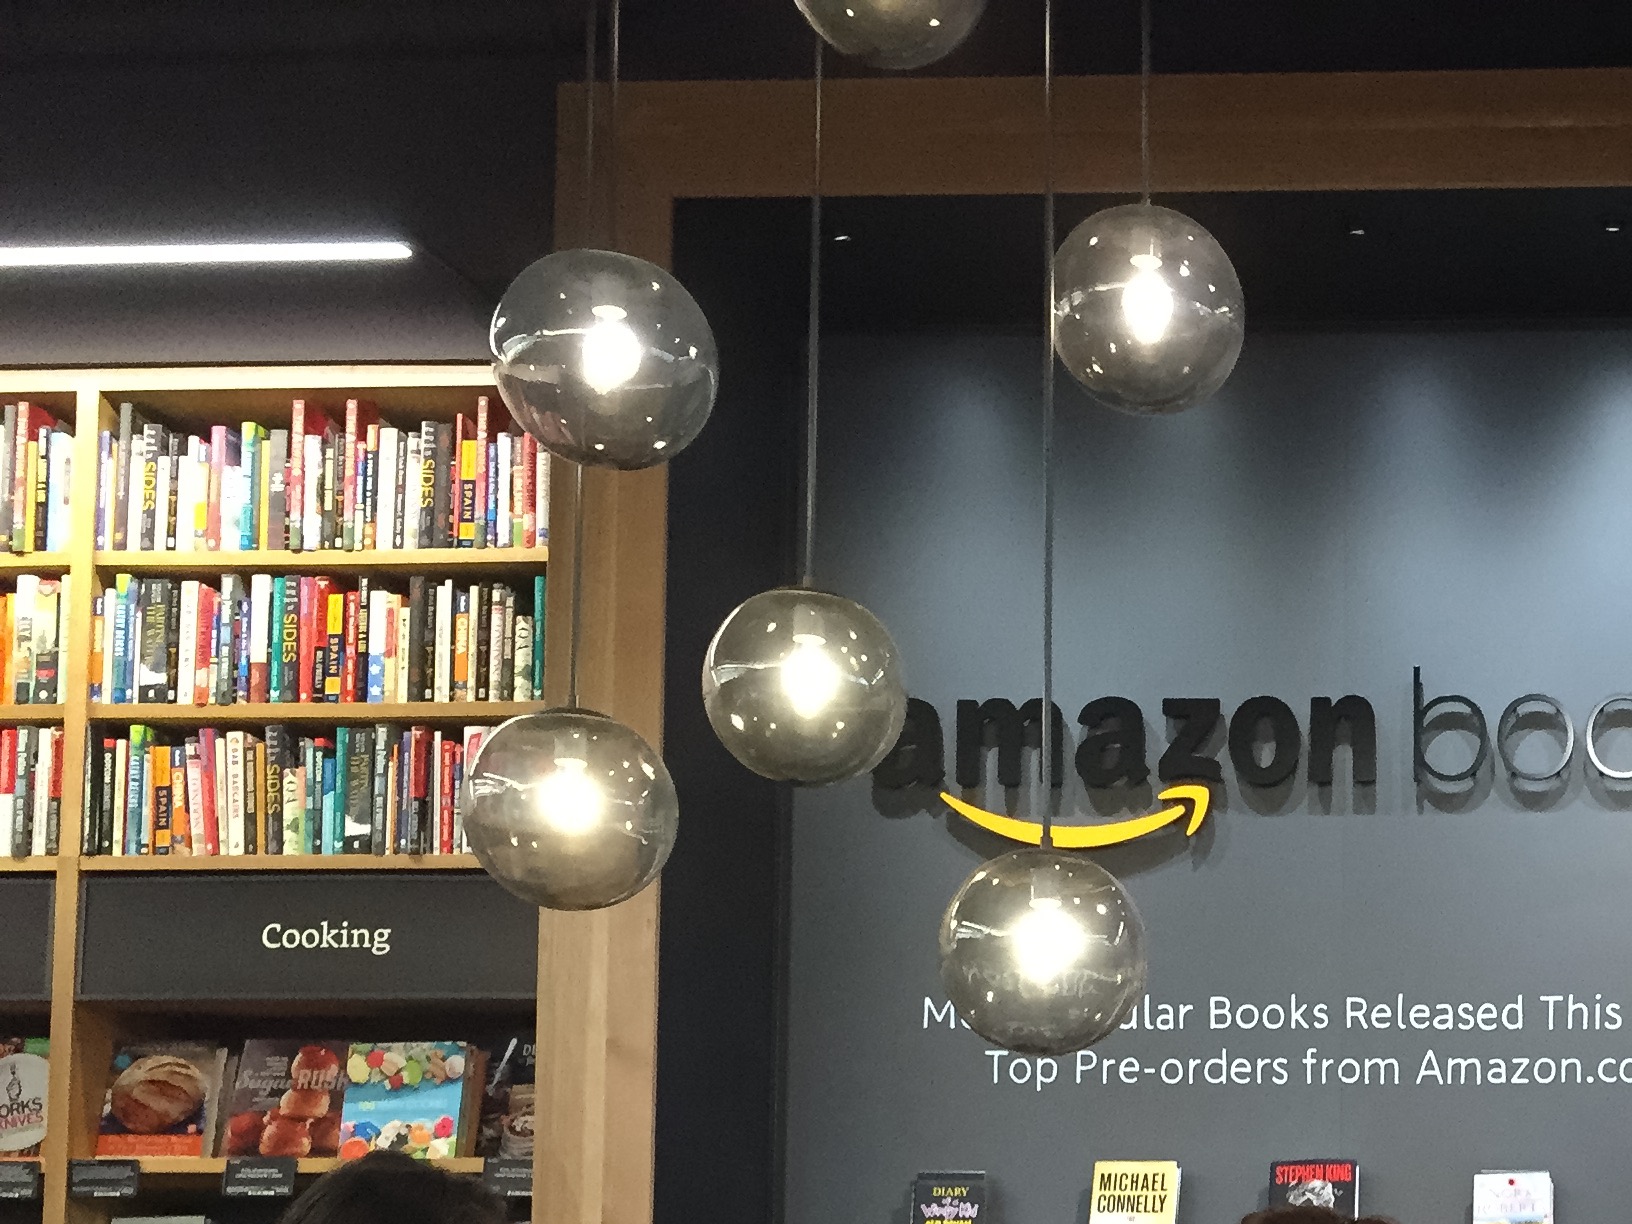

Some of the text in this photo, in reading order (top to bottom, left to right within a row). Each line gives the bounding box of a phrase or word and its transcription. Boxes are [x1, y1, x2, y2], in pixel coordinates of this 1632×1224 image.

[144, 461, 156, 511] SIDES
[423, 459, 436, 507] SIDES
[463, 484, 473, 520] SPAIN
[283, 613, 297, 663] SIDES
[329, 638, 339, 673] SPAIN
[873, 692, 1376, 789] amazon
[174, 771, 184, 808] CHINA
[267, 764, 280, 814] SIDES
[158, 790, 167, 826] SPAIN
[261, 921, 392, 956] Cooking
[1208, 994, 1330, 1032] Books
[1344, 993, 1532, 1033] Released
[1540, 993, 1625, 1032] This
[984, 1049, 1058, 1092] Top
[1074, 1049, 1291, 1088] Pre-orders
[1302, 1047, 1401, 1088] from
[0, 1097, 42, 1118] ORKS
[932, 1186, 970, 1197] DIARY
[1098, 1172, 1169, 1193] MICHAEL
[1275, 1163, 1353, 1185] STEPHEN KING
[1096, 1194, 1168, 1214] CONNELLY
